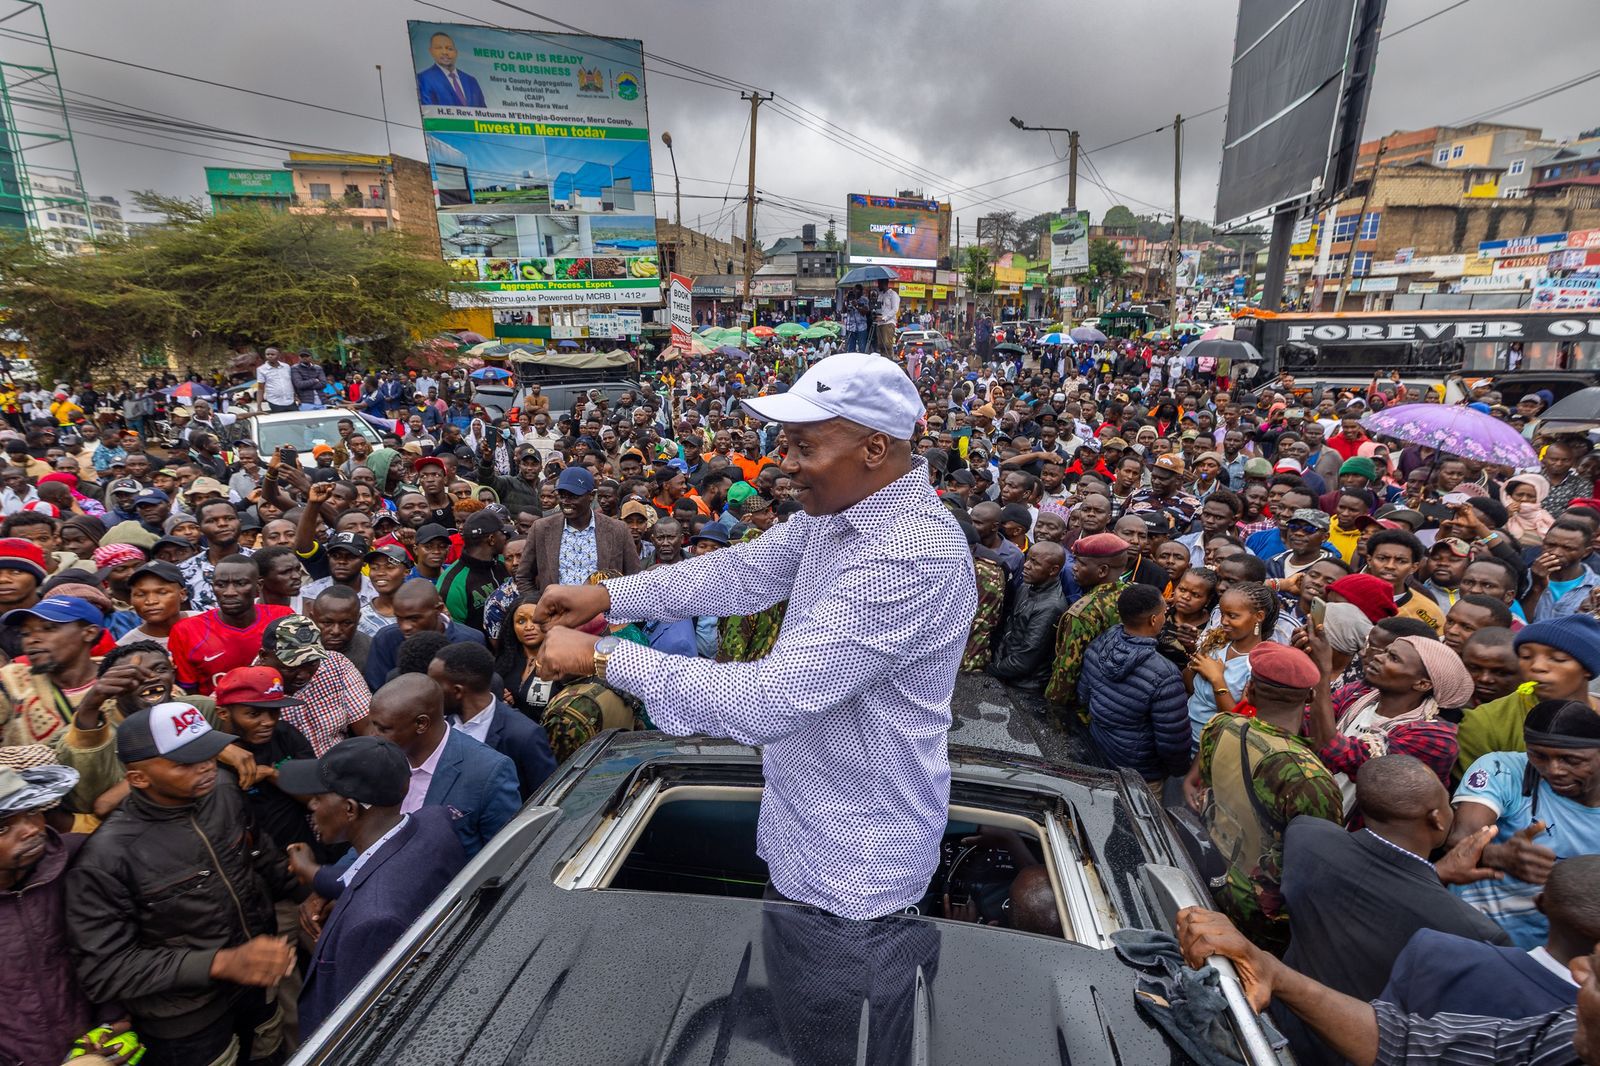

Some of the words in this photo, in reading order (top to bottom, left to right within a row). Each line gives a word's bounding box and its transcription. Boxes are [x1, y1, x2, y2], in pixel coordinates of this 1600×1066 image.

[473, 48, 505, 59] MERU
[508, 51, 533, 61] CAIP
[536, 53, 546, 62] IS
[549, 54, 584, 65] READY
[494, 63, 516, 73] FOR
[518, 65, 571, 76] BUSINESS
[490, 75, 507, 83] Meru
[508, 77, 532, 86] County
[533, 79, 573, 88] Aggregation
[512, 85, 544, 94] Industrial
[524, 94, 545, 102] (CAIP)
[456, 109, 473, 117] Rev.
[475, 110, 507, 118] Mutuma
[586, 116, 605, 124] Meru
[607, 117, 633, 126] County.
[474, 120, 516, 134] Invest
[519, 122, 531, 135] in
[535, 123, 568, 137] Meru
[571, 126, 607, 140] today
[1506, 236, 1537, 247] DAIMA
[1500, 244, 1540, 256] CHEMIST
[500, 283, 546, 291] Aggregate.
[548, 281, 583, 289] Process.
[585, 280, 614, 289] Export.
[1473, 275, 1511, 286] DAIMA
[1552, 278, 1598, 289] SECTION
[538, 293, 573, 302] Powered
[574, 293, 584, 302] by
[586, 292, 611, 300] MCRB
[673, 288, 689, 300] BOOK
[672, 301, 690, 313] THESE
[671, 313, 692, 325] SPACES
[1286, 319, 1525, 342] FOREVER
